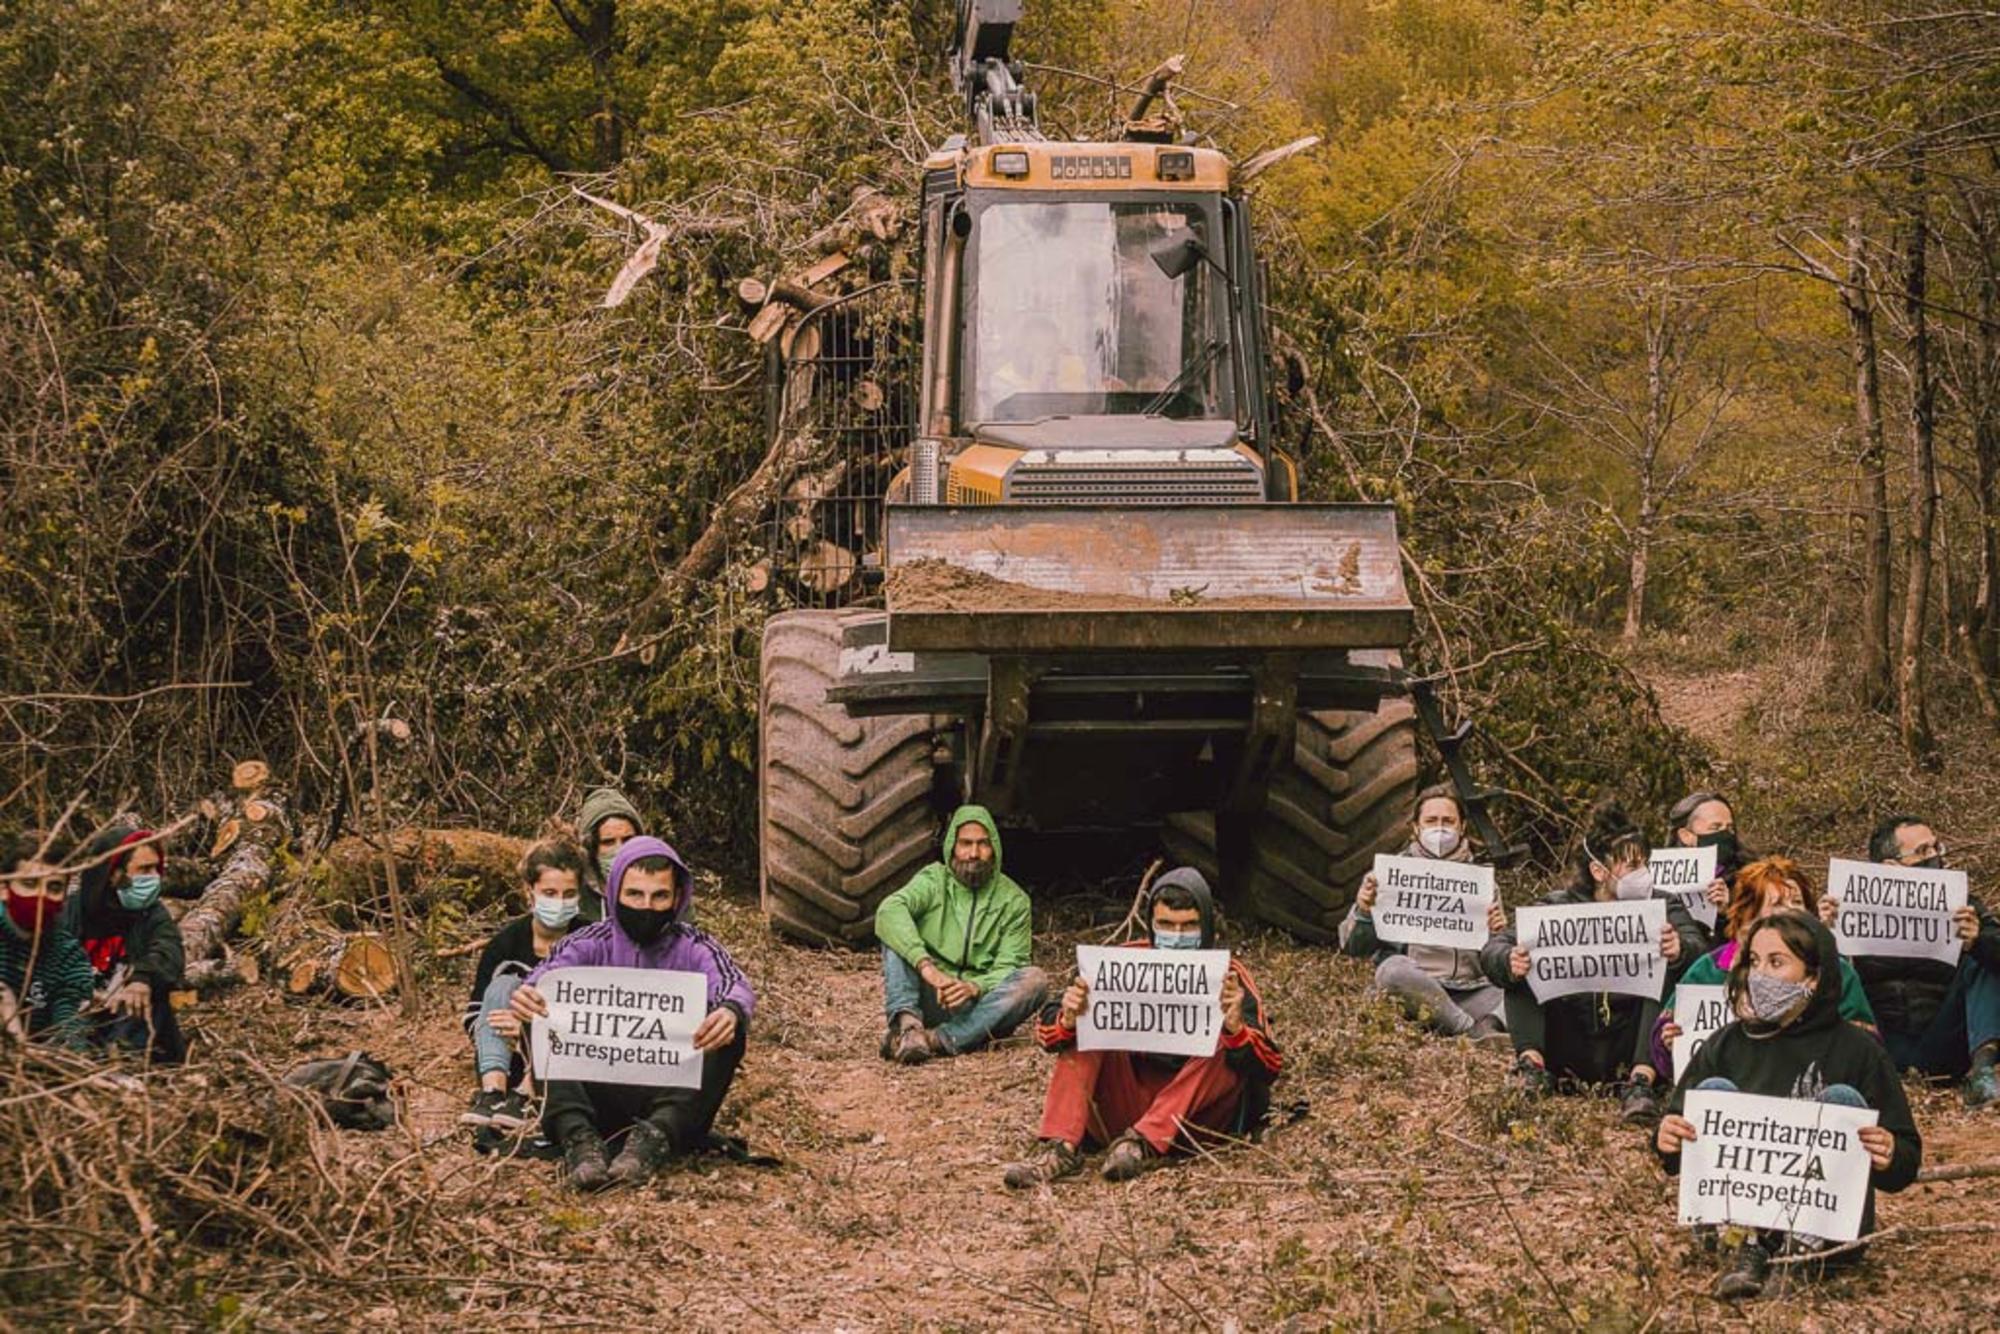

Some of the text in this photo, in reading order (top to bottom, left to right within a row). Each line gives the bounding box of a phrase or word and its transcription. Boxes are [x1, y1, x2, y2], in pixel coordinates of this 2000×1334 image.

[1387, 868, 1478, 895] Herritarren
[1648, 859, 1698, 885] TEGIA
[1396, 891, 1466, 914] HITZA
[1843, 874, 1948, 912] AROZTEGIA
[1382, 911, 1474, 932] errespetatu
[1536, 914, 1649, 948] AROZTEGIA
[1841, 910, 1951, 945] GELDITU !
[1094, 960, 1210, 995] AROZTEGIA
[1536, 953, 1653, 981] GELDITU !
[555, 980, 684, 1013] Herritarren
[569, 1011, 667, 1041] HITZA
[1093, 1000, 1211, 1036] GELDITU !
[551, 1038, 680, 1066] errespetatu
[1702, 1109, 1848, 1151] Herritarren
[1715, 1144, 1826, 1181] HITZA
[1698, 1178, 1838, 1212] errespetatu
